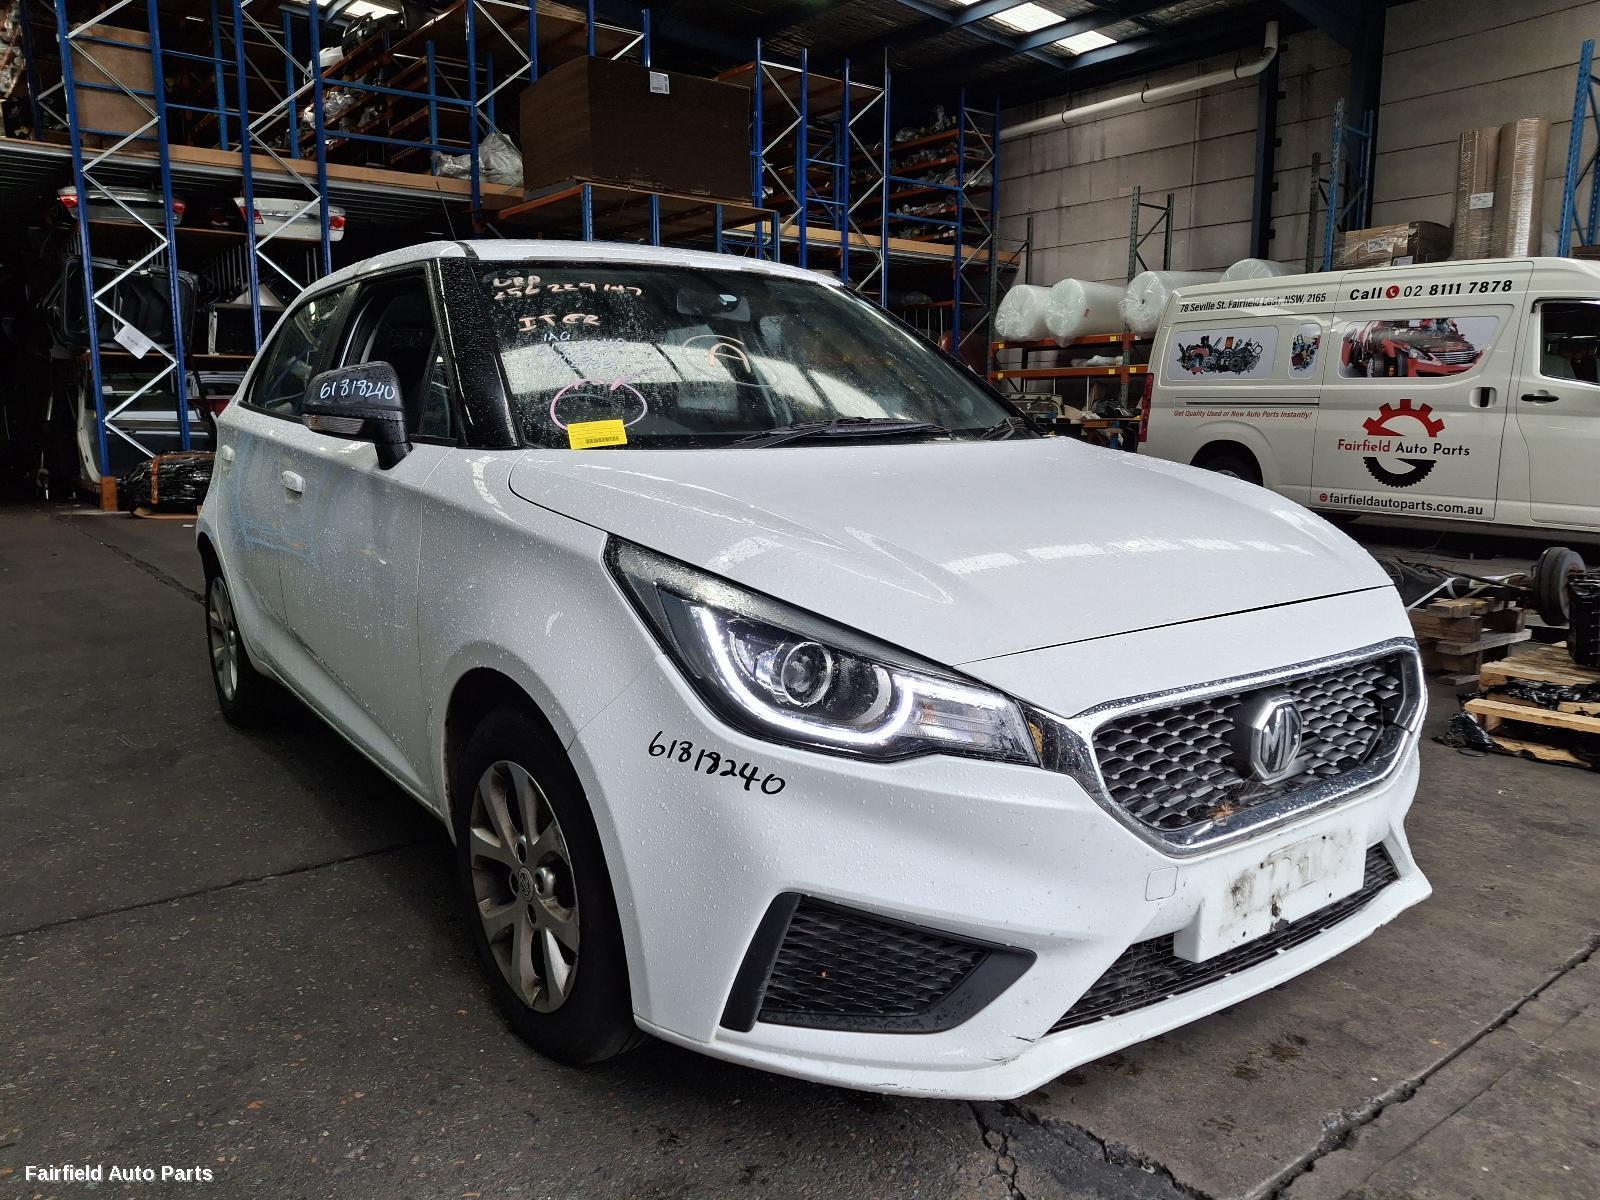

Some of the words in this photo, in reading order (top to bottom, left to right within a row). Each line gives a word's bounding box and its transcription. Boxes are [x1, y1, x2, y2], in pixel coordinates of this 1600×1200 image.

[1350, 286, 1382, 300] Call
[1404, 285, 1423, 297] 02
[1429, 282, 1462, 295] 8111
[1468, 280, 1513, 294] 7878
[1180, 304, 1188, 312] 78
[1190, 302, 1215, 312] Seville
[1216, 301, 1226, 310] St.
[1307, 293, 1327, 303] 2165
[320, 378, 396, 400] 61818240
[1185, 410, 1205, 418] Quality
[1280, 411, 1313, 419] Instantly!
[1337, 438, 1391, 453] Fairfield
[1395, 442, 1428, 454] Auto
[1433, 442, 1470, 456] Parts
[1329, 492, 1483, 515] fairfieldautoparts.com.au
[648, 730, 786, 795] 61818240
